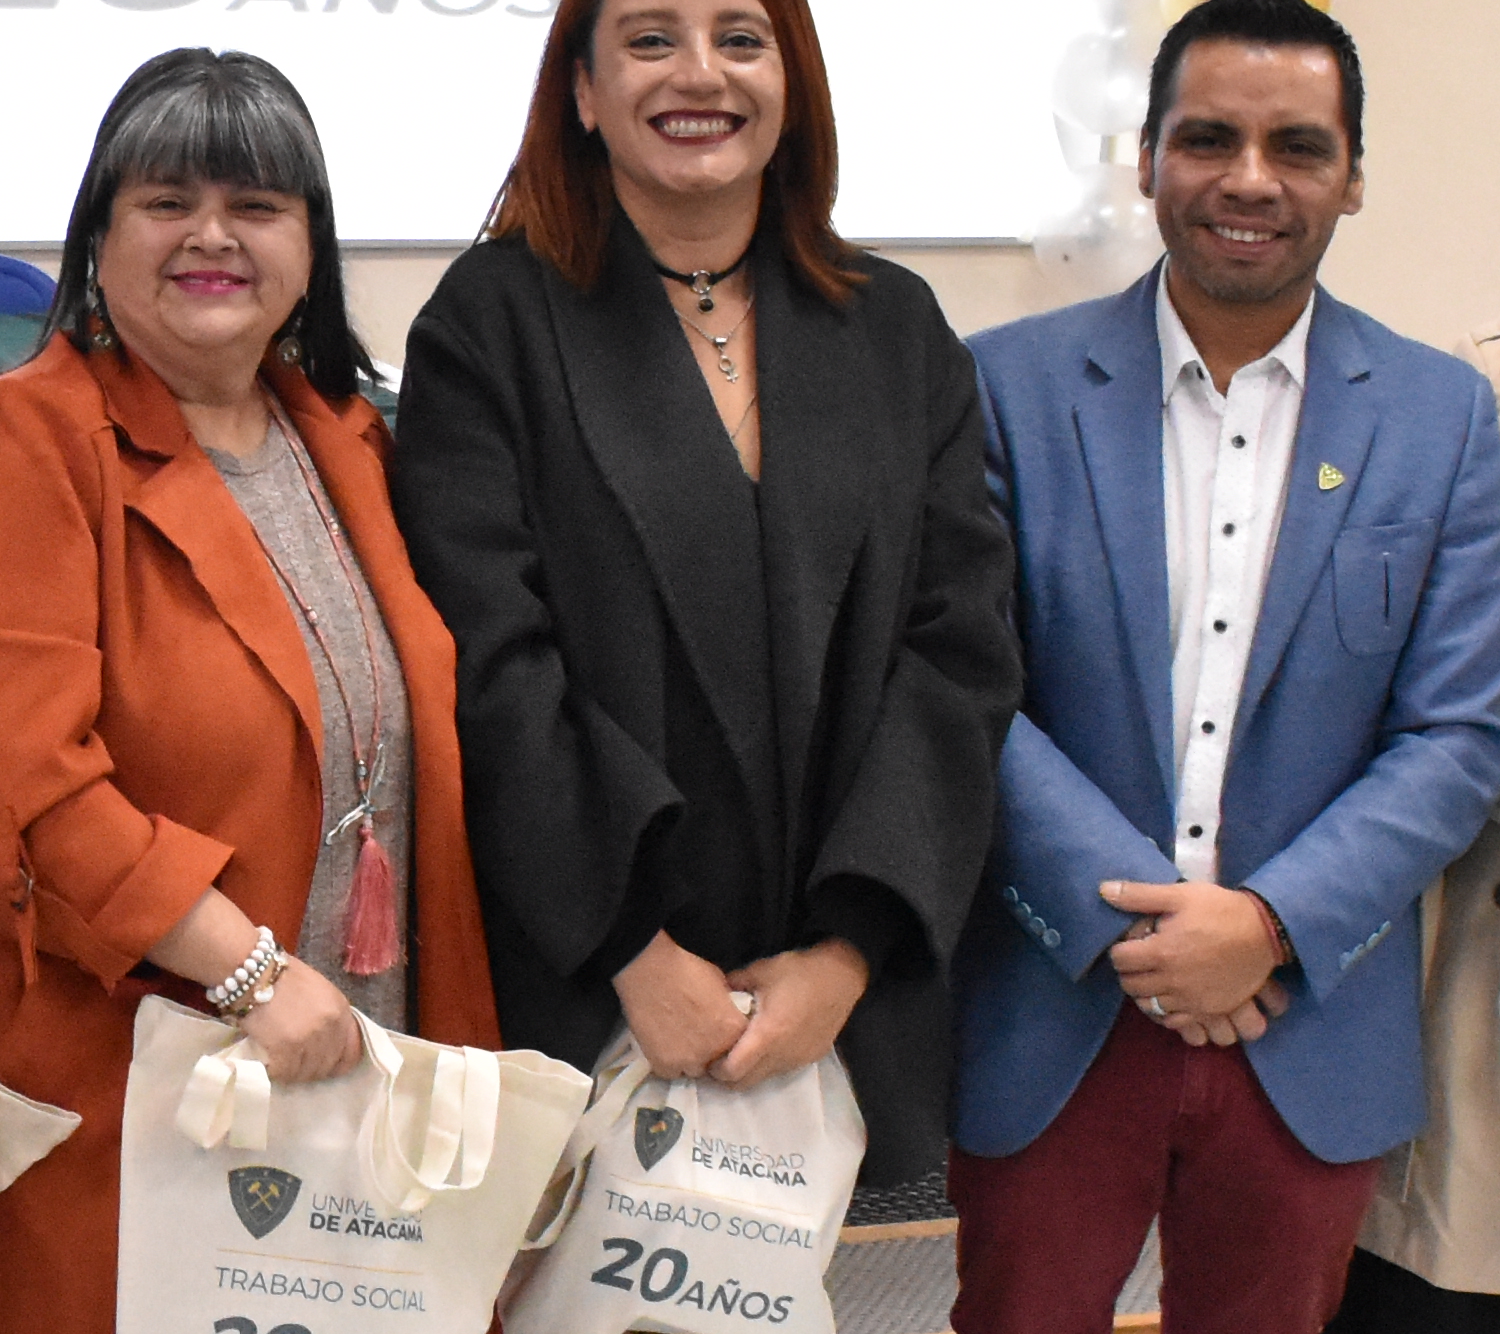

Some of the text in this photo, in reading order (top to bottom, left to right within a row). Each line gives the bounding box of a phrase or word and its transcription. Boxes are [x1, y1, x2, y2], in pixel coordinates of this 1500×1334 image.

[692, 1147, 806, 1187] DE ATACAMA
[310, 1212, 423, 1242] DE ATACAMA
[604, 1190, 814, 1249] TRABAJO SOCIAL
[215, 1266, 426, 1313] TRABAJO SOCIAL
